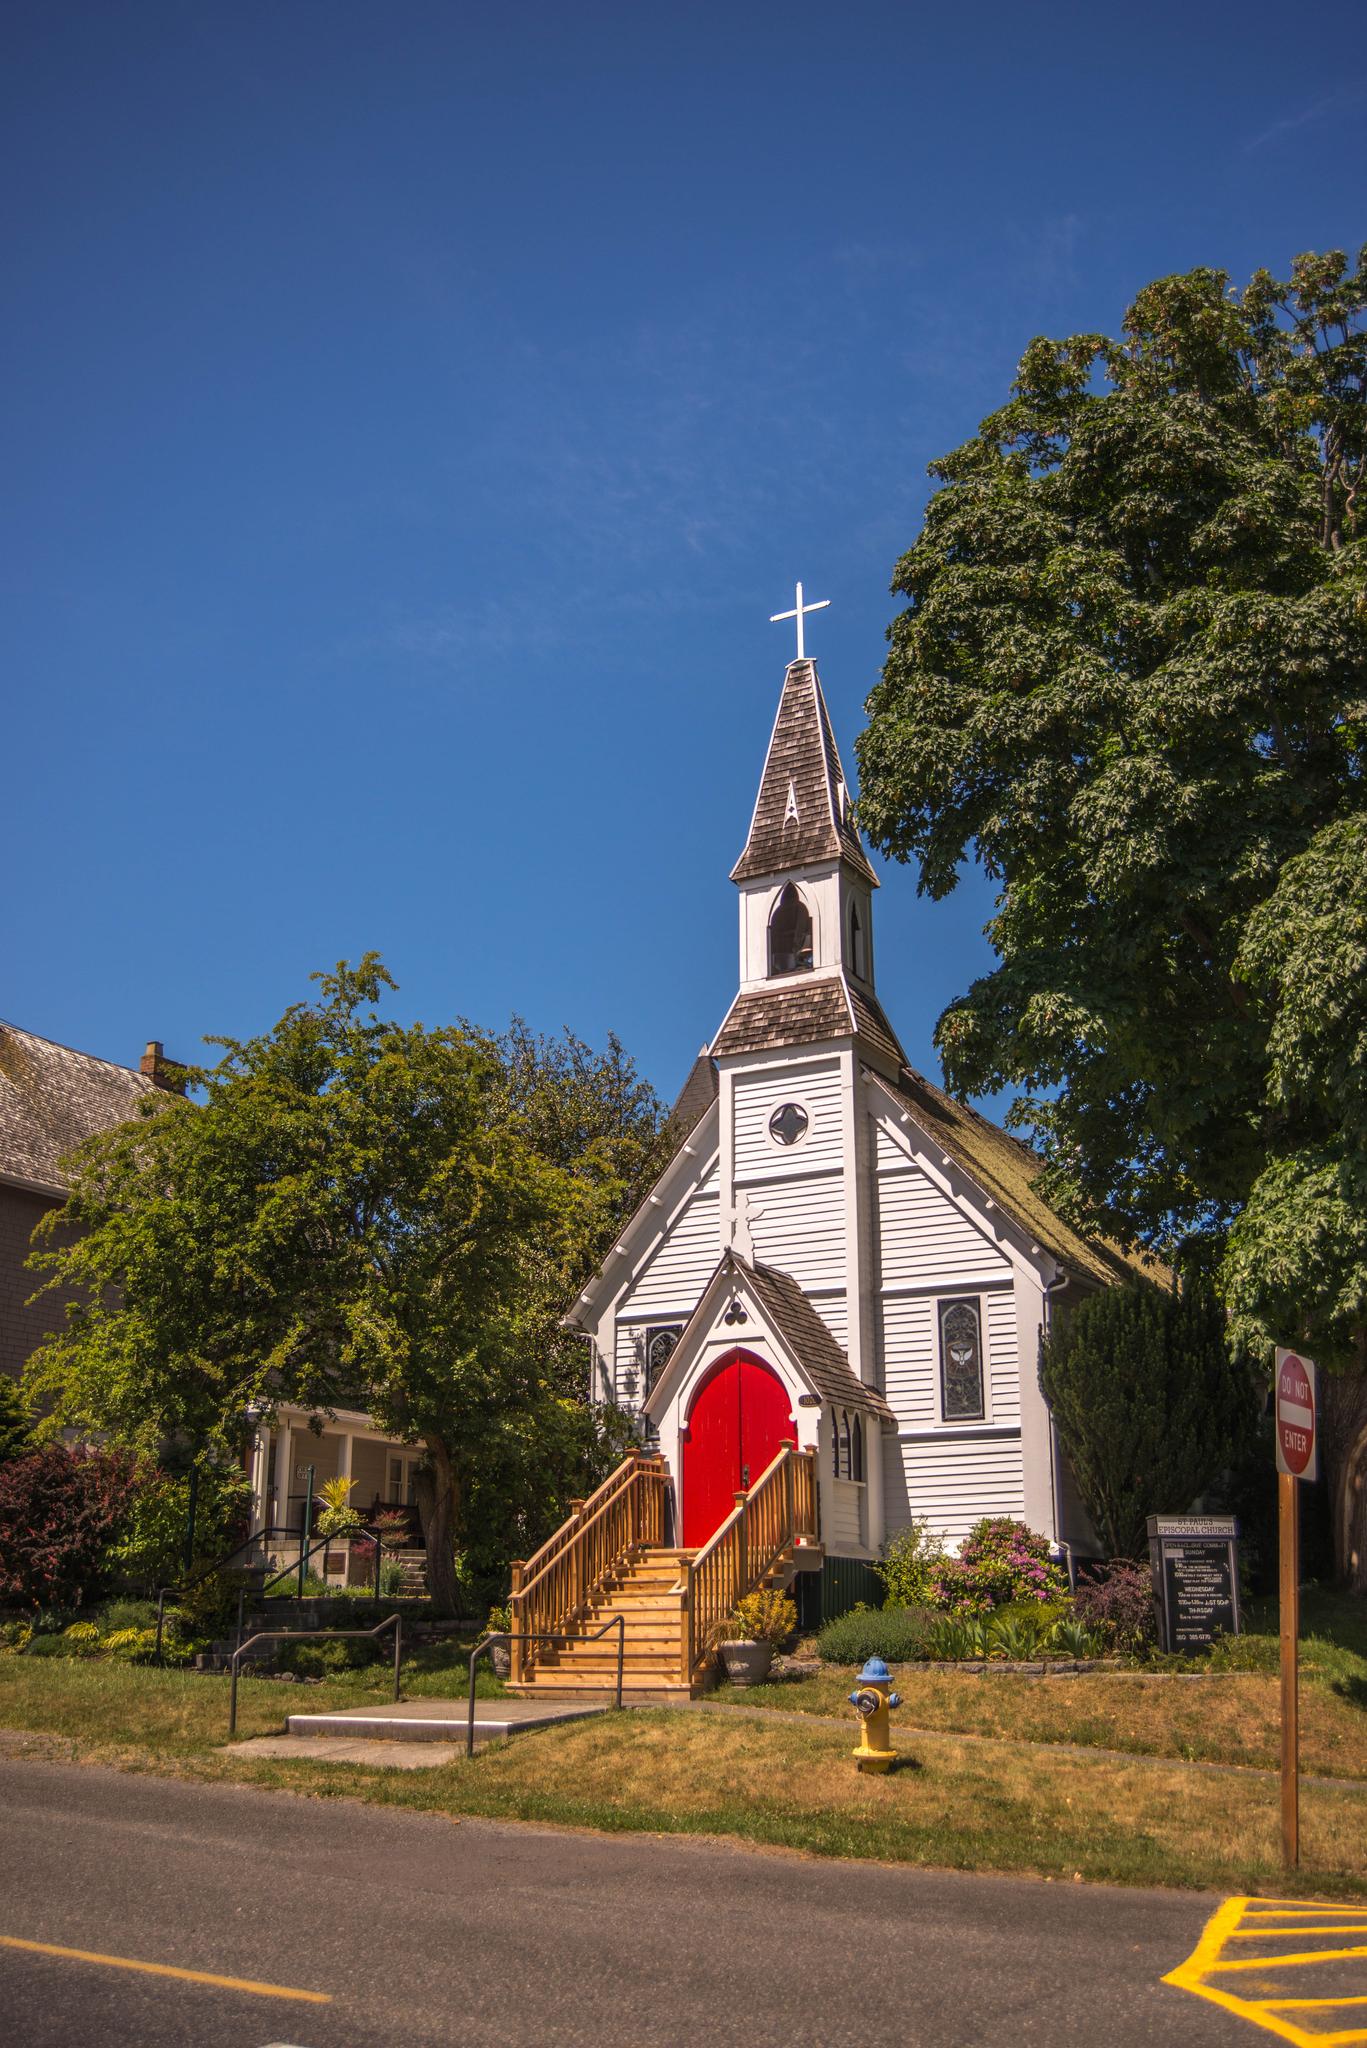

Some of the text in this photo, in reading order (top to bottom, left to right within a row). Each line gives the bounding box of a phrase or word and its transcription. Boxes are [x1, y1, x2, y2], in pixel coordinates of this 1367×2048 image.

[1282, 1375, 1309, 1401] DO NOT
[1284, 1430, 1307, 1453] ENTER
[1158, 1526, 1233, 1534] EPISCOPAL CHURCH
